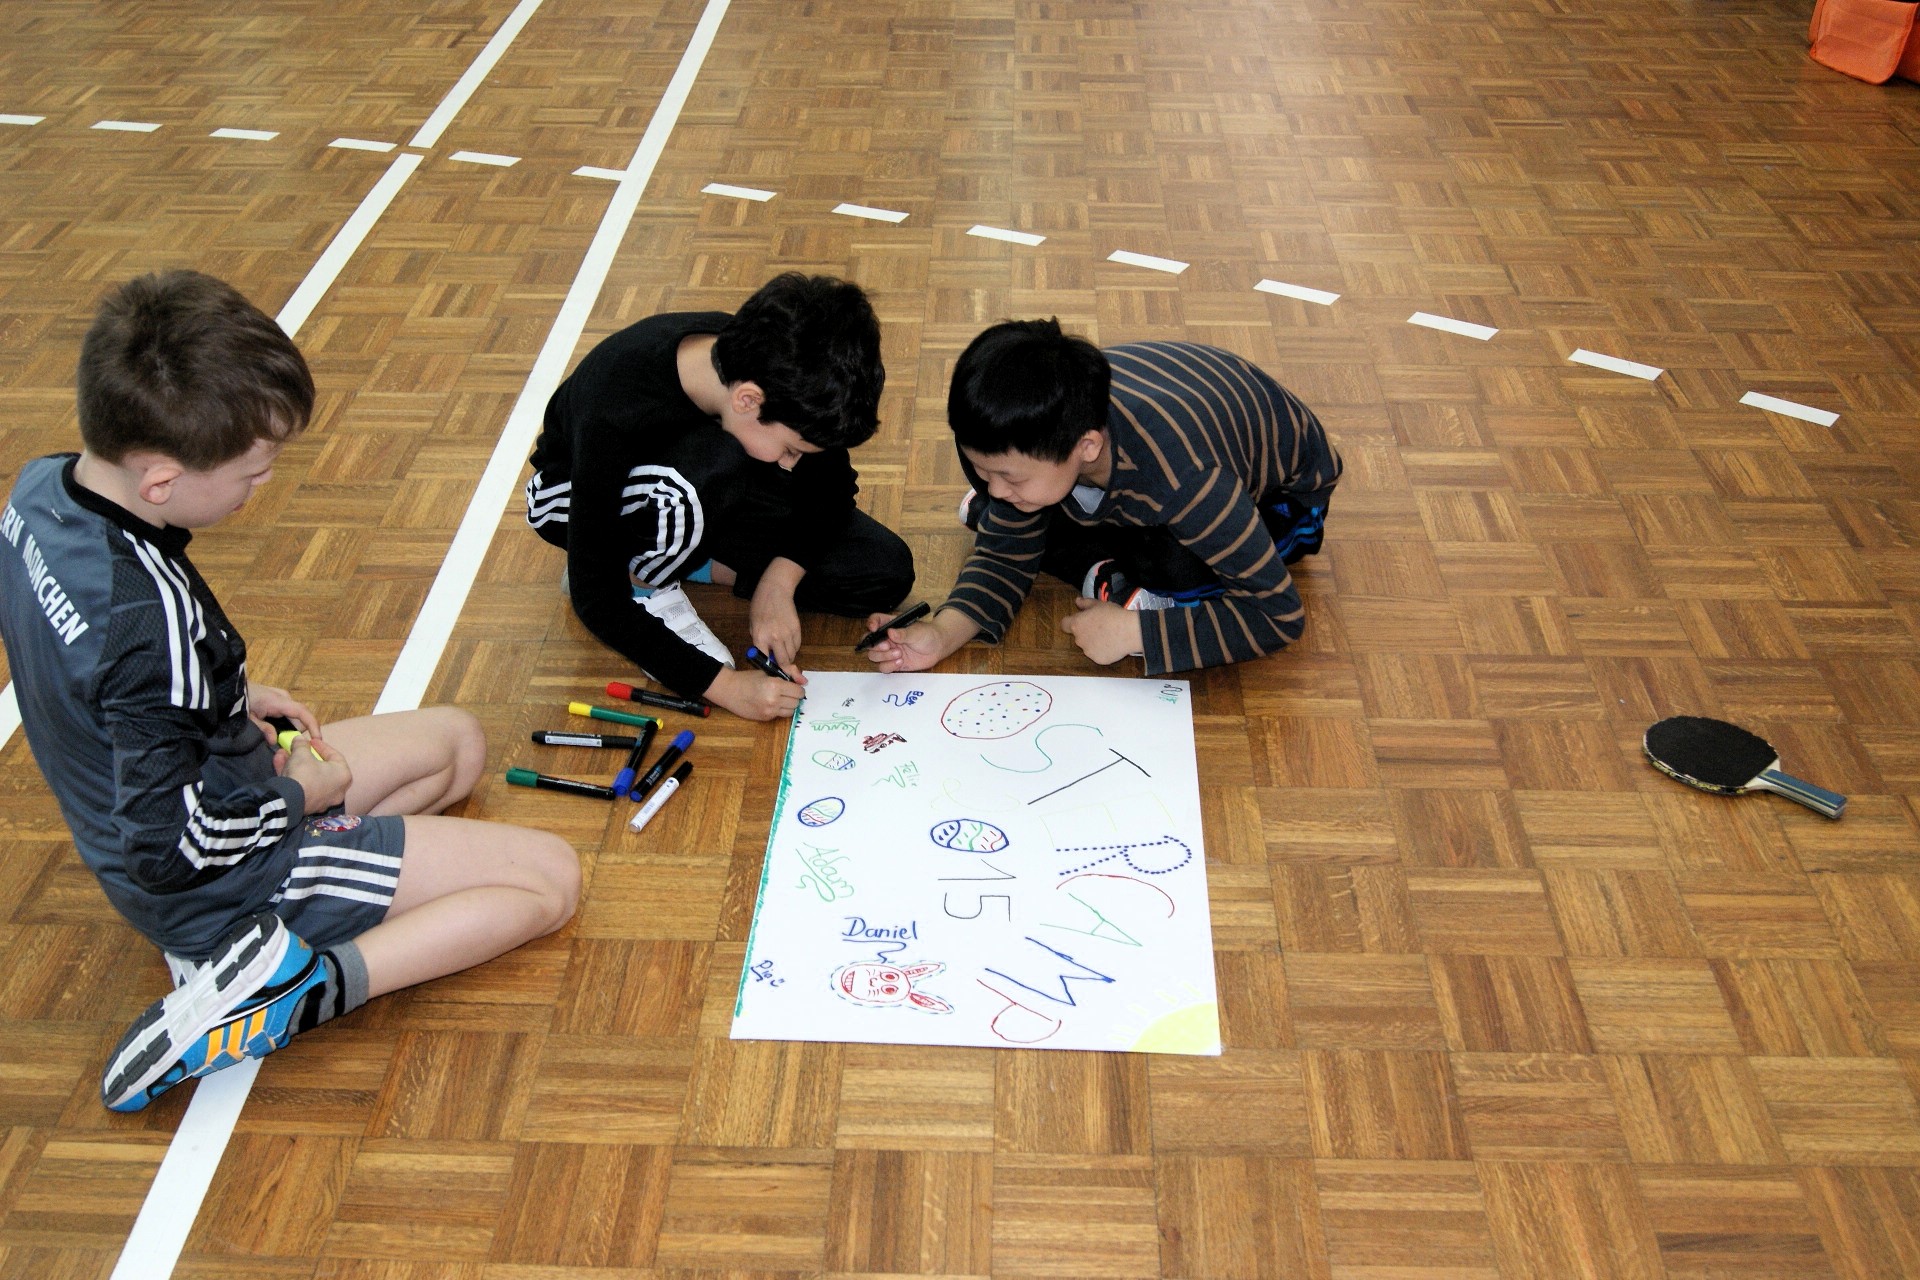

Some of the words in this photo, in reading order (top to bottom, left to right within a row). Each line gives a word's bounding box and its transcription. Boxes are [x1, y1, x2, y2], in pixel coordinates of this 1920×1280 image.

[811, 722, 860, 737] Kevin
[803, 842, 855, 899] Adam
[842, 917, 918, 940] Daniel
